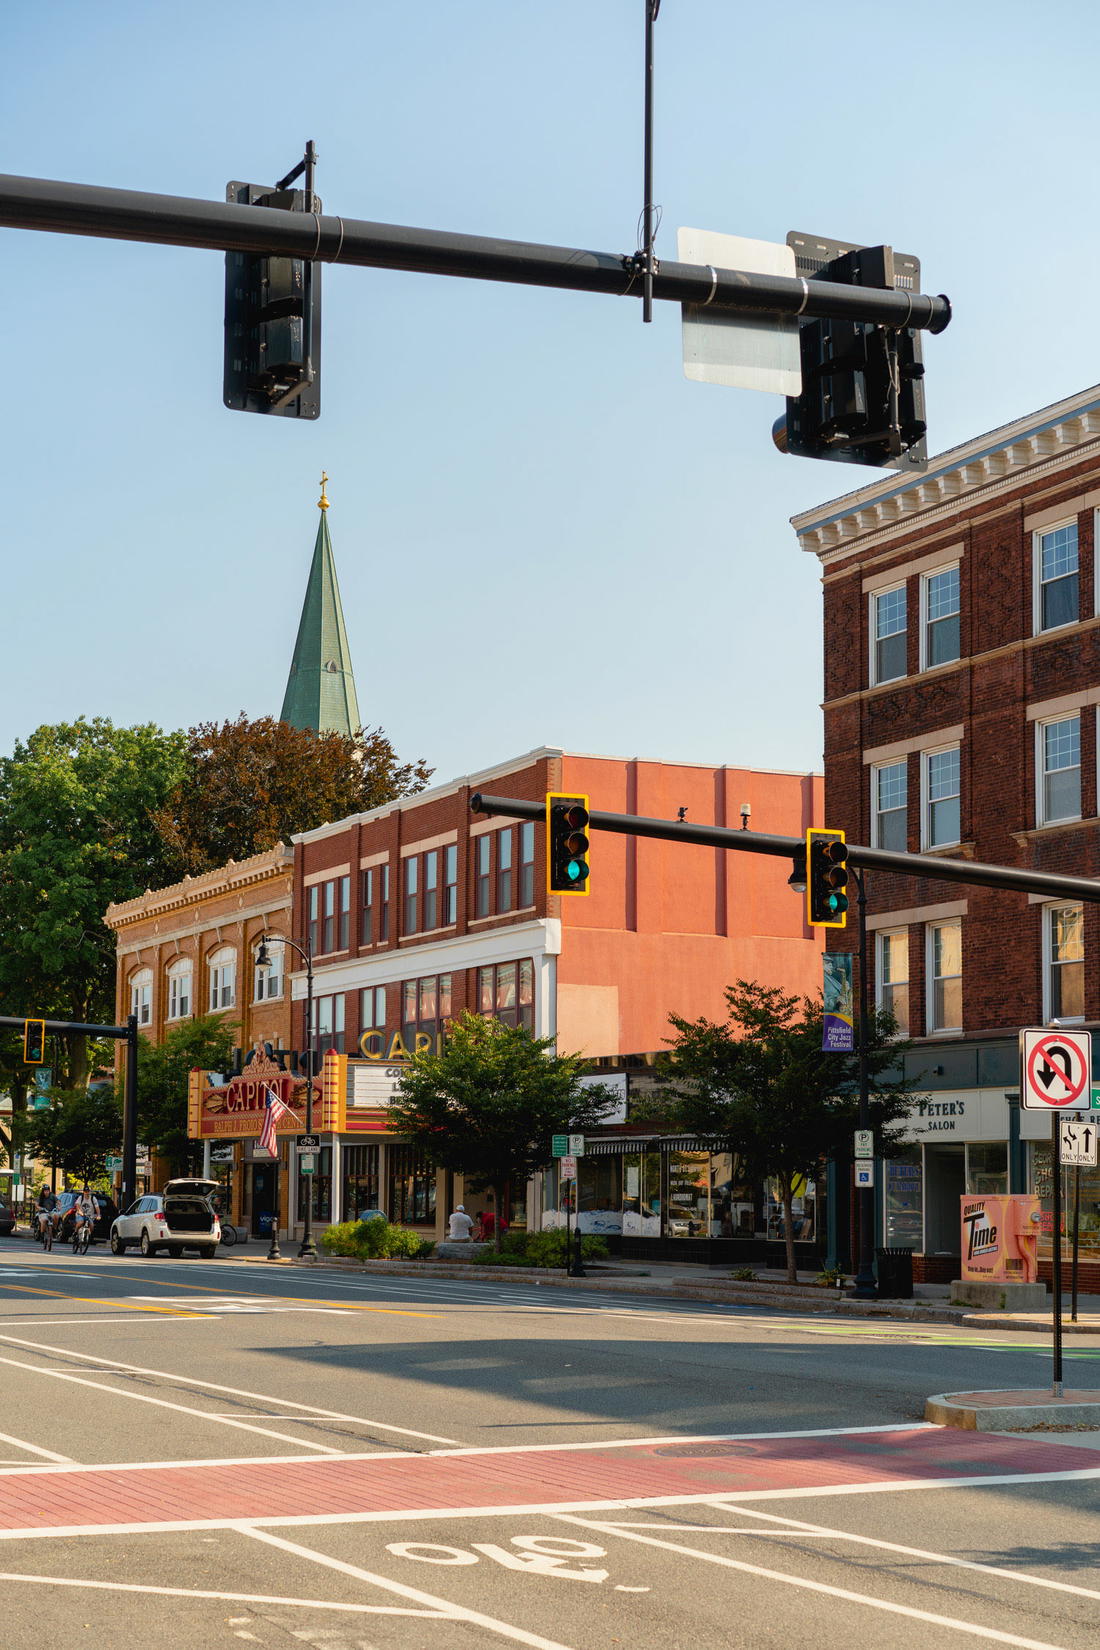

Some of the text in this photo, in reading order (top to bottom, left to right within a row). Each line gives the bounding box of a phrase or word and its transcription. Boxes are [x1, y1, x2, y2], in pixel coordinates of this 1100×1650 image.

[226, 1079, 290, 1112] CAPITOL
[919, 1101, 965, 1117] PETER'S
[928, 1121, 955, 1131] SALON
[1079, 1154, 1094, 1162] ONLY
[964, 1201, 985, 1215] QUALITY
[963, 1212, 997, 1261] Time
